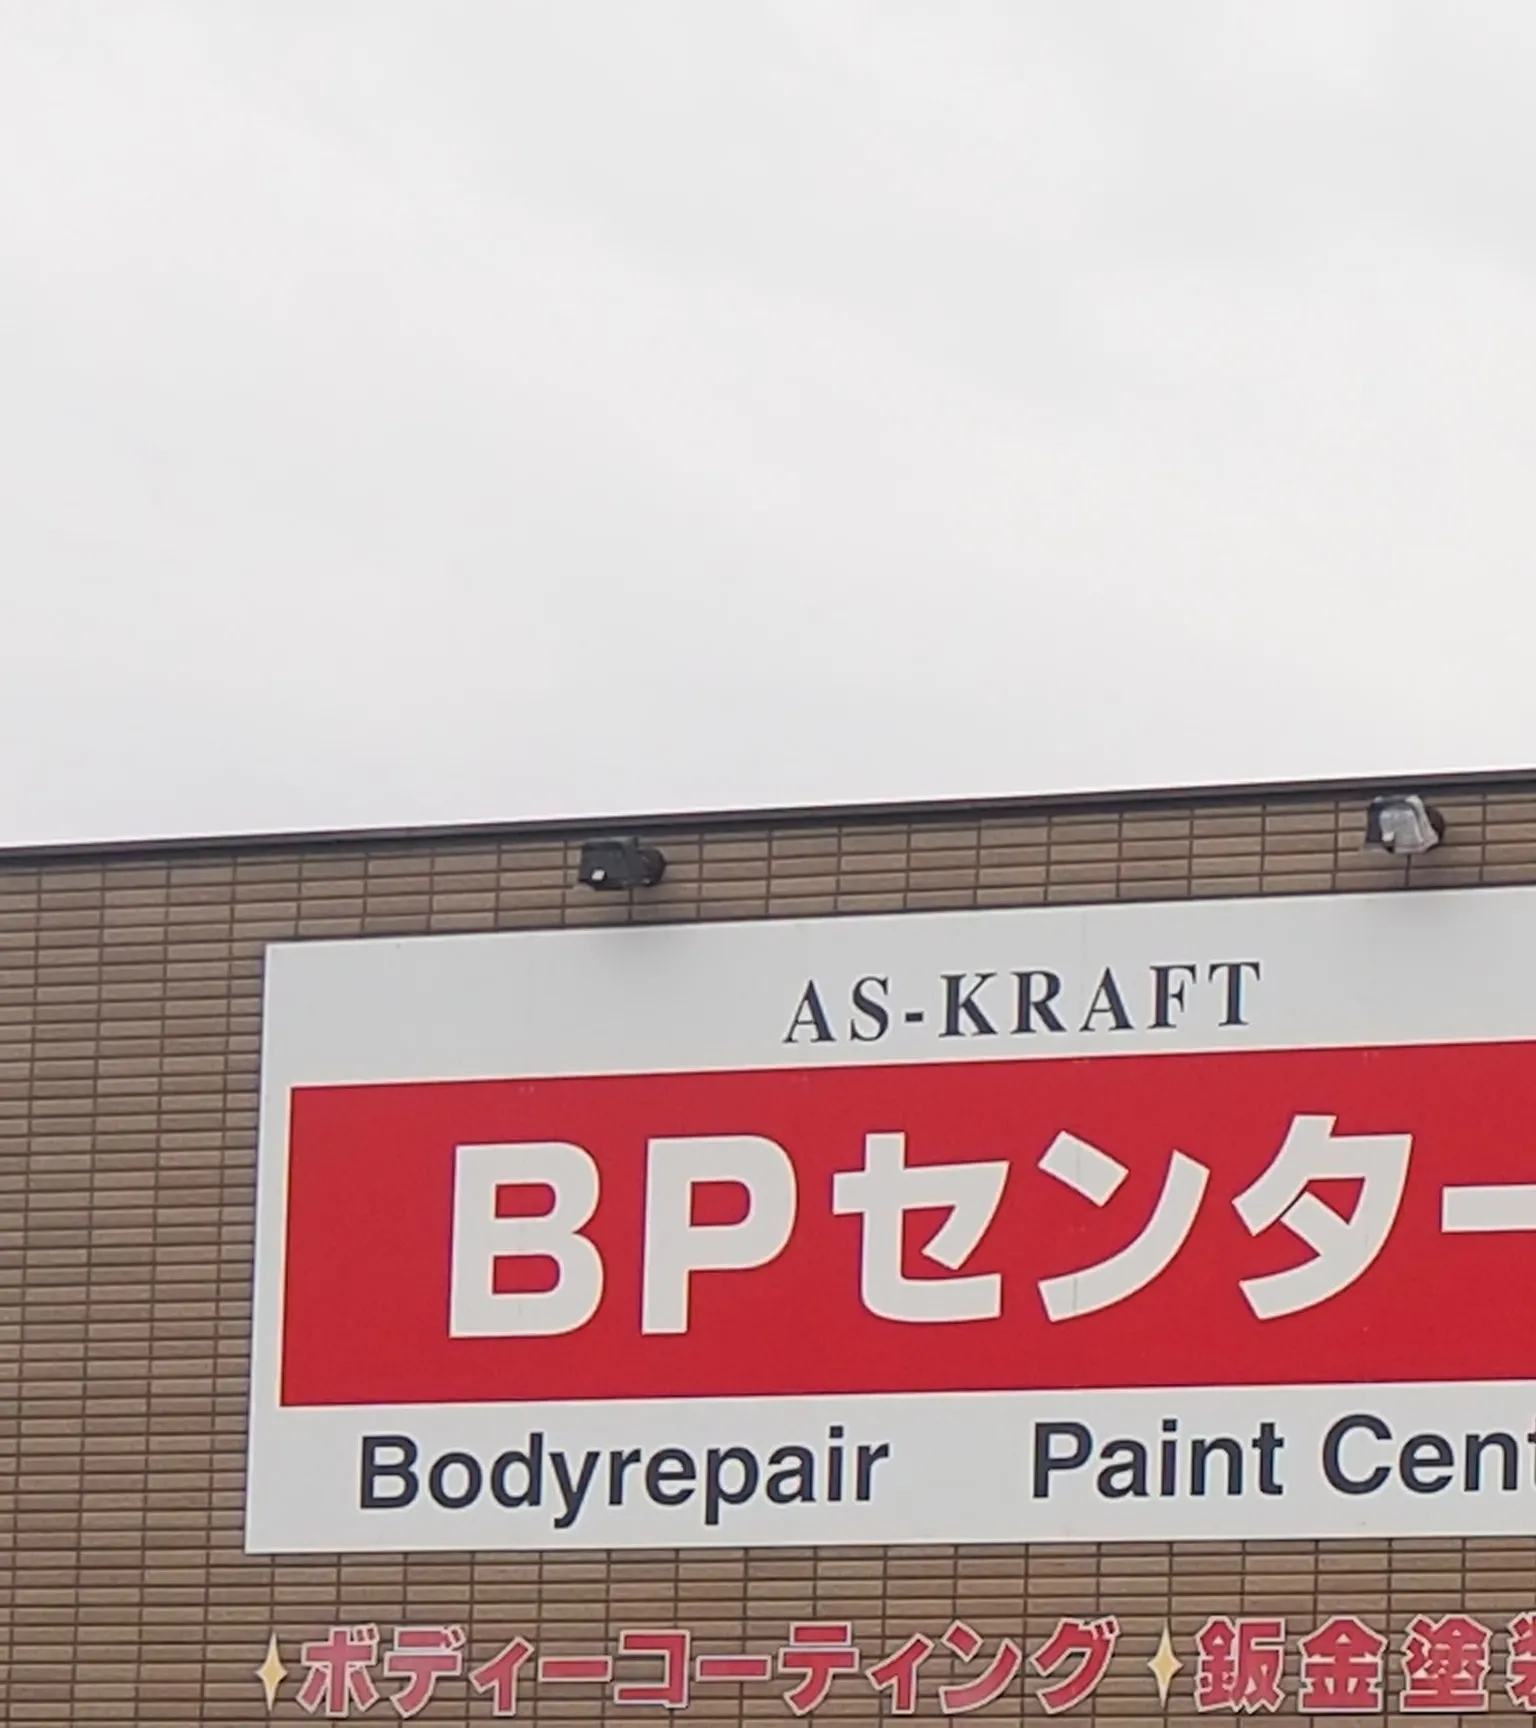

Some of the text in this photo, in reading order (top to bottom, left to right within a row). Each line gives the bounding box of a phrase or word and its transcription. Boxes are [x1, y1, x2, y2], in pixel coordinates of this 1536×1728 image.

[782, 961, 1261, 1044] AS-KRAFT
[359, 1426, 889, 1528] Bodyrepair
[1032, 1418, 1284, 1498] Paint
[295, 1615, 1120, 1717] ボディーコーティング
